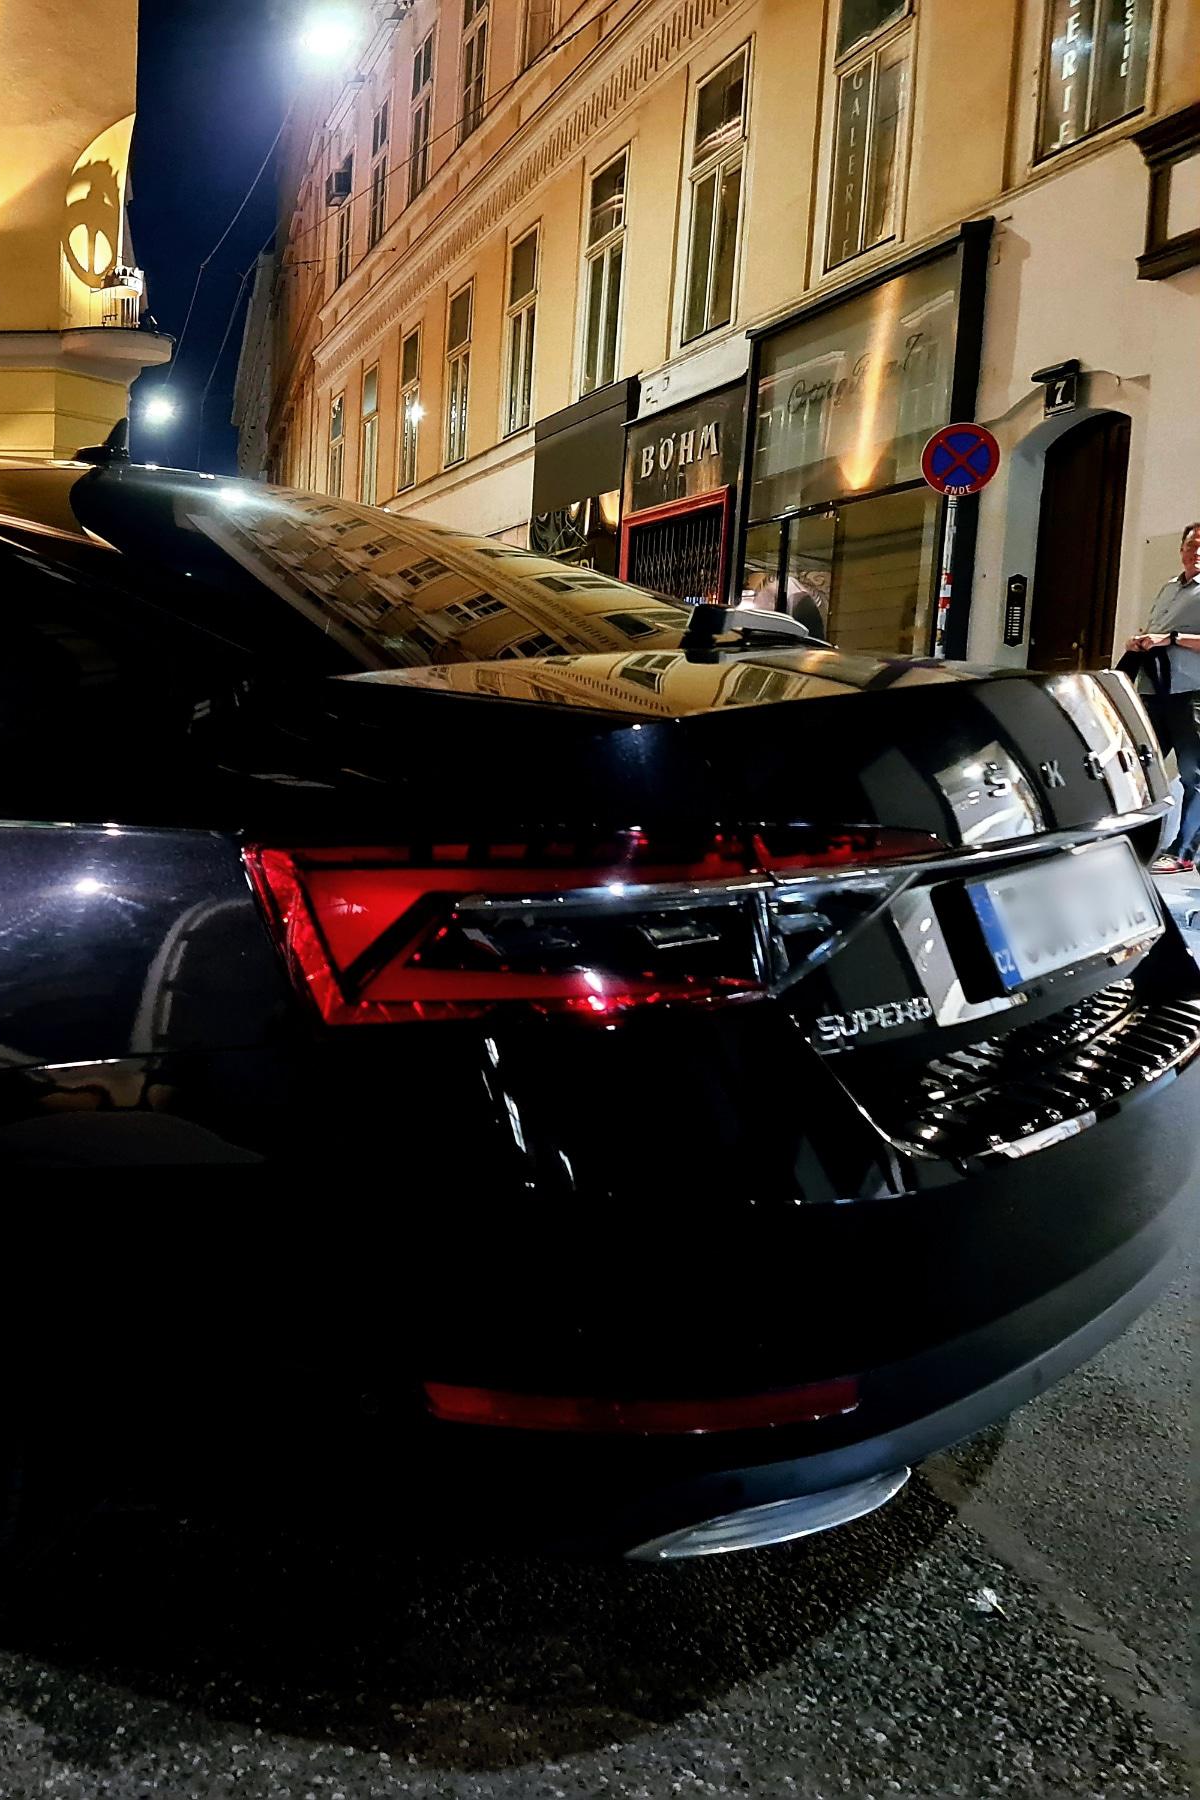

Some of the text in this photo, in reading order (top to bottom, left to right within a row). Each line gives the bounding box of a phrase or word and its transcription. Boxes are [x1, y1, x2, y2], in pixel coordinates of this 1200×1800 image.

[1054, 380, 1067, 405] 7
[640, 420, 720, 479] BÖHM
[943, 484, 972, 495] ENDE
[994, 950, 1017, 975] CZ
[815, 998, 933, 1041] SUPERB
